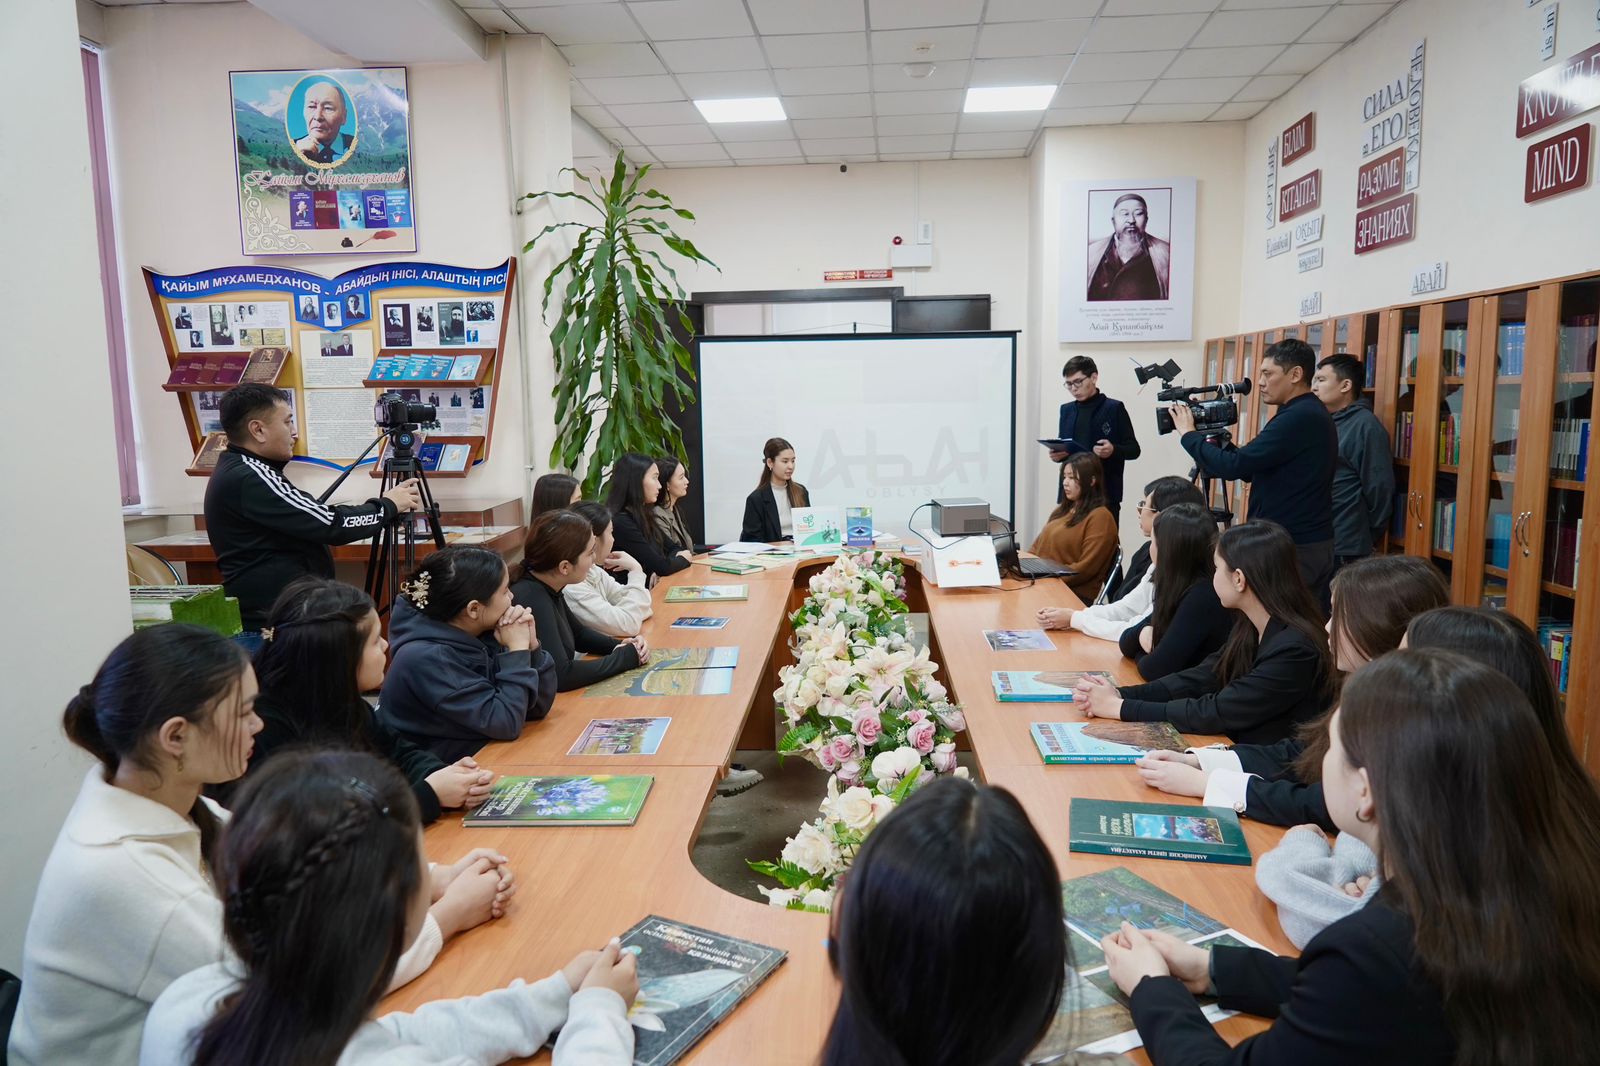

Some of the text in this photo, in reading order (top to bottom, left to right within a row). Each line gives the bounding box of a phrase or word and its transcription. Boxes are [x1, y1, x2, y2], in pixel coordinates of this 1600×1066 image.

[1363, 79, 1404, 120] СИЛА
[1406, 44, 1423, 163] ЧЕЛОВЕКА
[1371, 112, 1403, 152] ЕГО
[1359, 156, 1401, 201] РАЗУМЕ
[1531, 136, 1580, 194] MIND
[1357, 203, 1411, 249] ЗНАНИЯХ
[161, 278, 210, 293] ҚАЙЫМ
[212, 273, 322, 295] МҰХАМЕДХАНОВ
[335, 271, 390, 296] АБАЙДЫҢ
[391, 269, 419, 281] ІНІСІ,
[421, 270, 481, 288] АЛАШТЫҢ
[482, 272, 507, 287] ІРІСІ
[1412, 262, 1443, 293] АБАЙ
[1300, 292, 1319, 315] АБАЙ
[342, 513, 380, 528] TERREX
[1168, 852, 1208, 860] АЛЬПИЙСКИЕ
